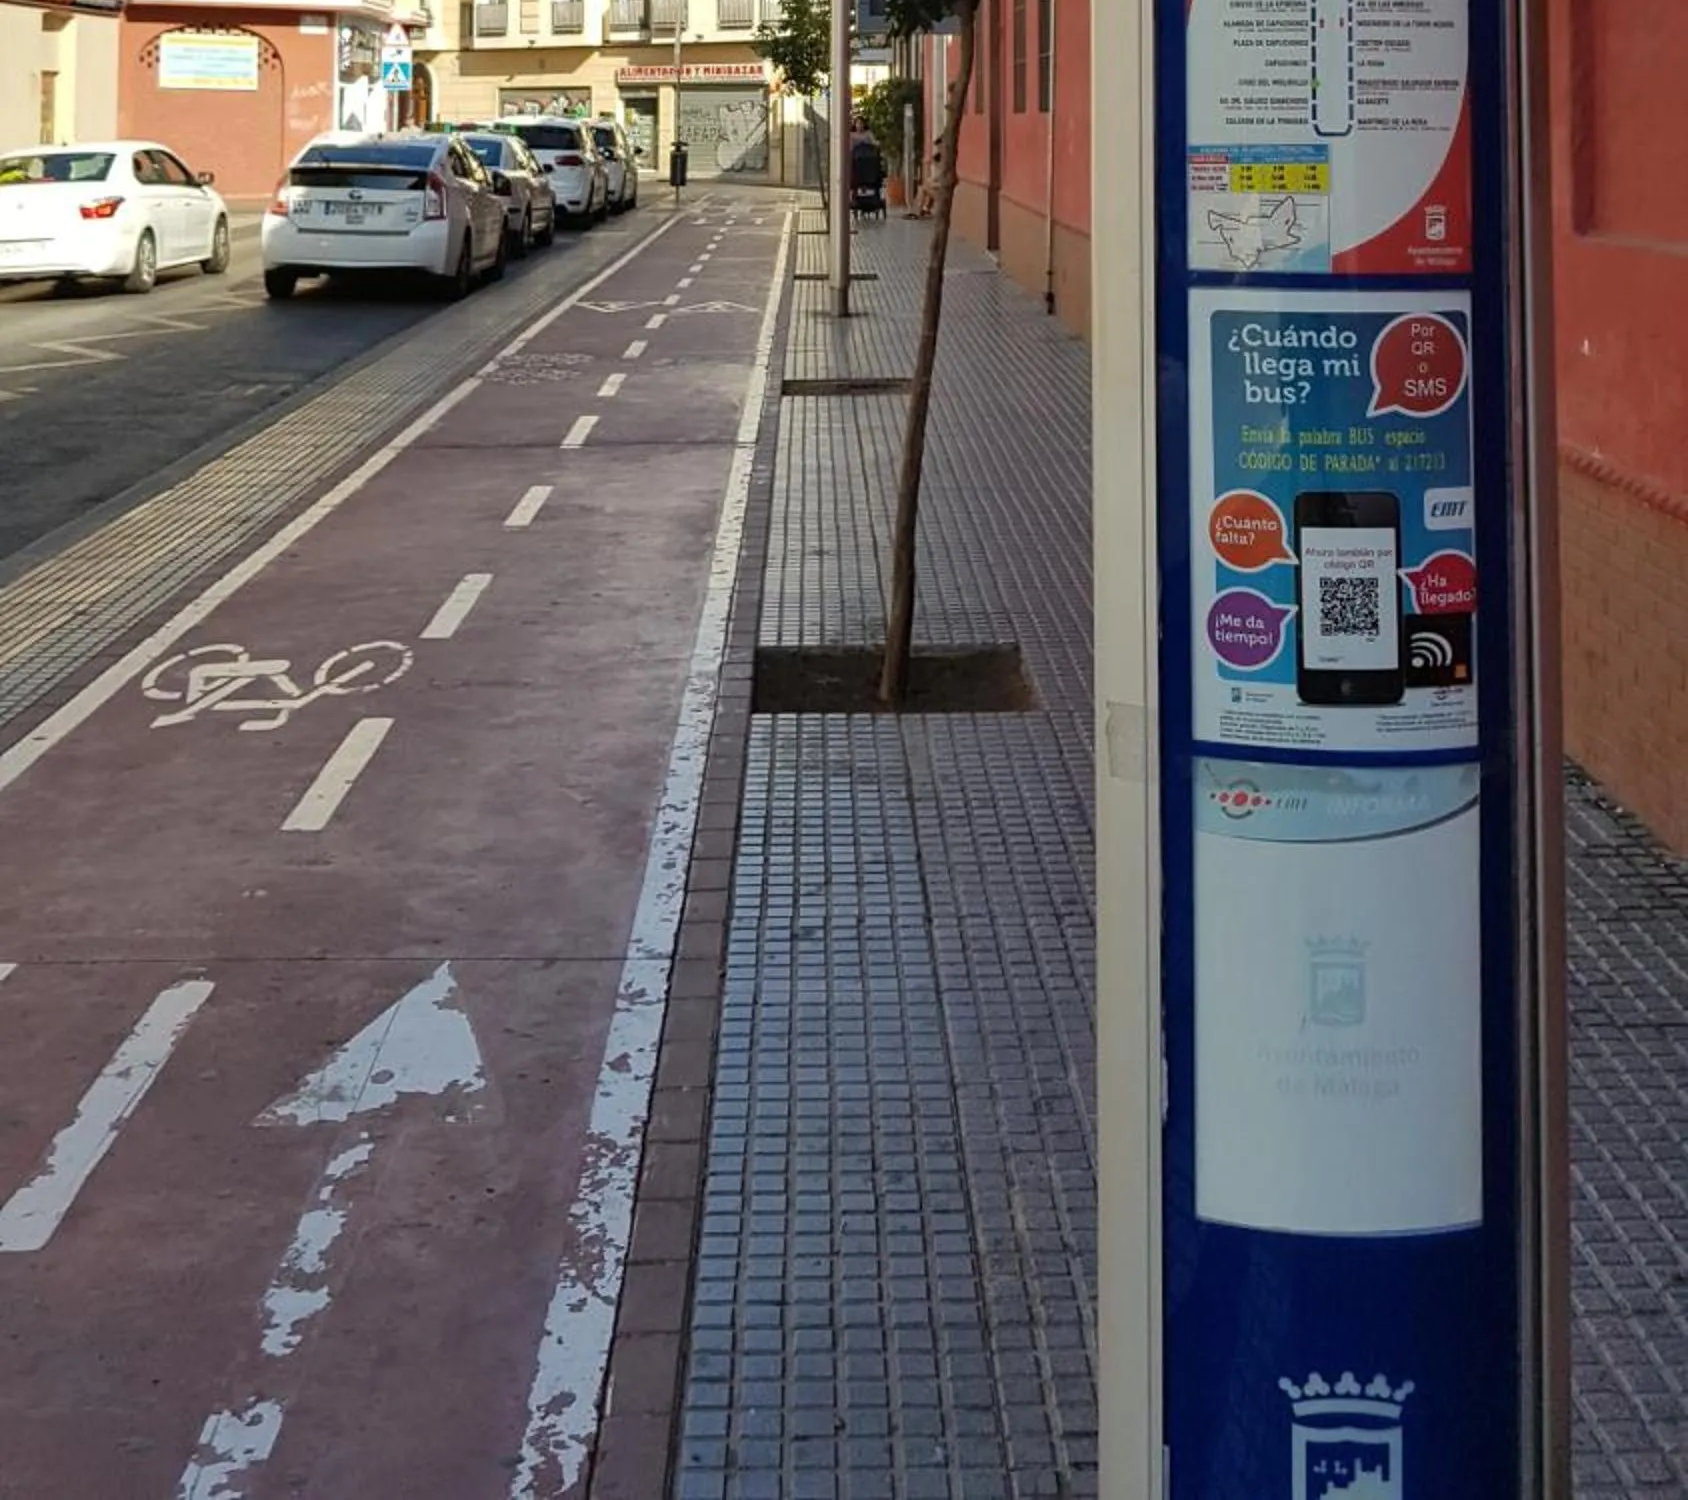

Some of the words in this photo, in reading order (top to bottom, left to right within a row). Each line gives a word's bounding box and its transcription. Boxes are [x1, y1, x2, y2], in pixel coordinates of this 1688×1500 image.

[1227, 322, 1357, 352] ¿Cuándo
[1411, 323, 1434, 337] Por
[1410, 342, 1435, 356] QR
[1244, 352, 1315, 381] llega
[1323, 354, 1361, 377] mi
[1419, 363, 1428, 373] o
[1244, 381, 1312, 404] bus?
[1403, 377, 1448, 397] SMS
[1348, 427, 1374, 445] BUS
[1300, 453, 1317, 471] DE
[1215, 515, 1278, 531] ¿Cuánto
[1215, 530, 1256, 545] falta?
[1358, 559, 1375, 569] QR
[1420, 573, 1447, 590] ¿Ha
[1419, 587, 1477, 605] llegado?
[1215, 613, 1242, 628] ¡Me
[1245, 615, 1265, 629] da
[1215, 628, 1273, 648] tiempo!
